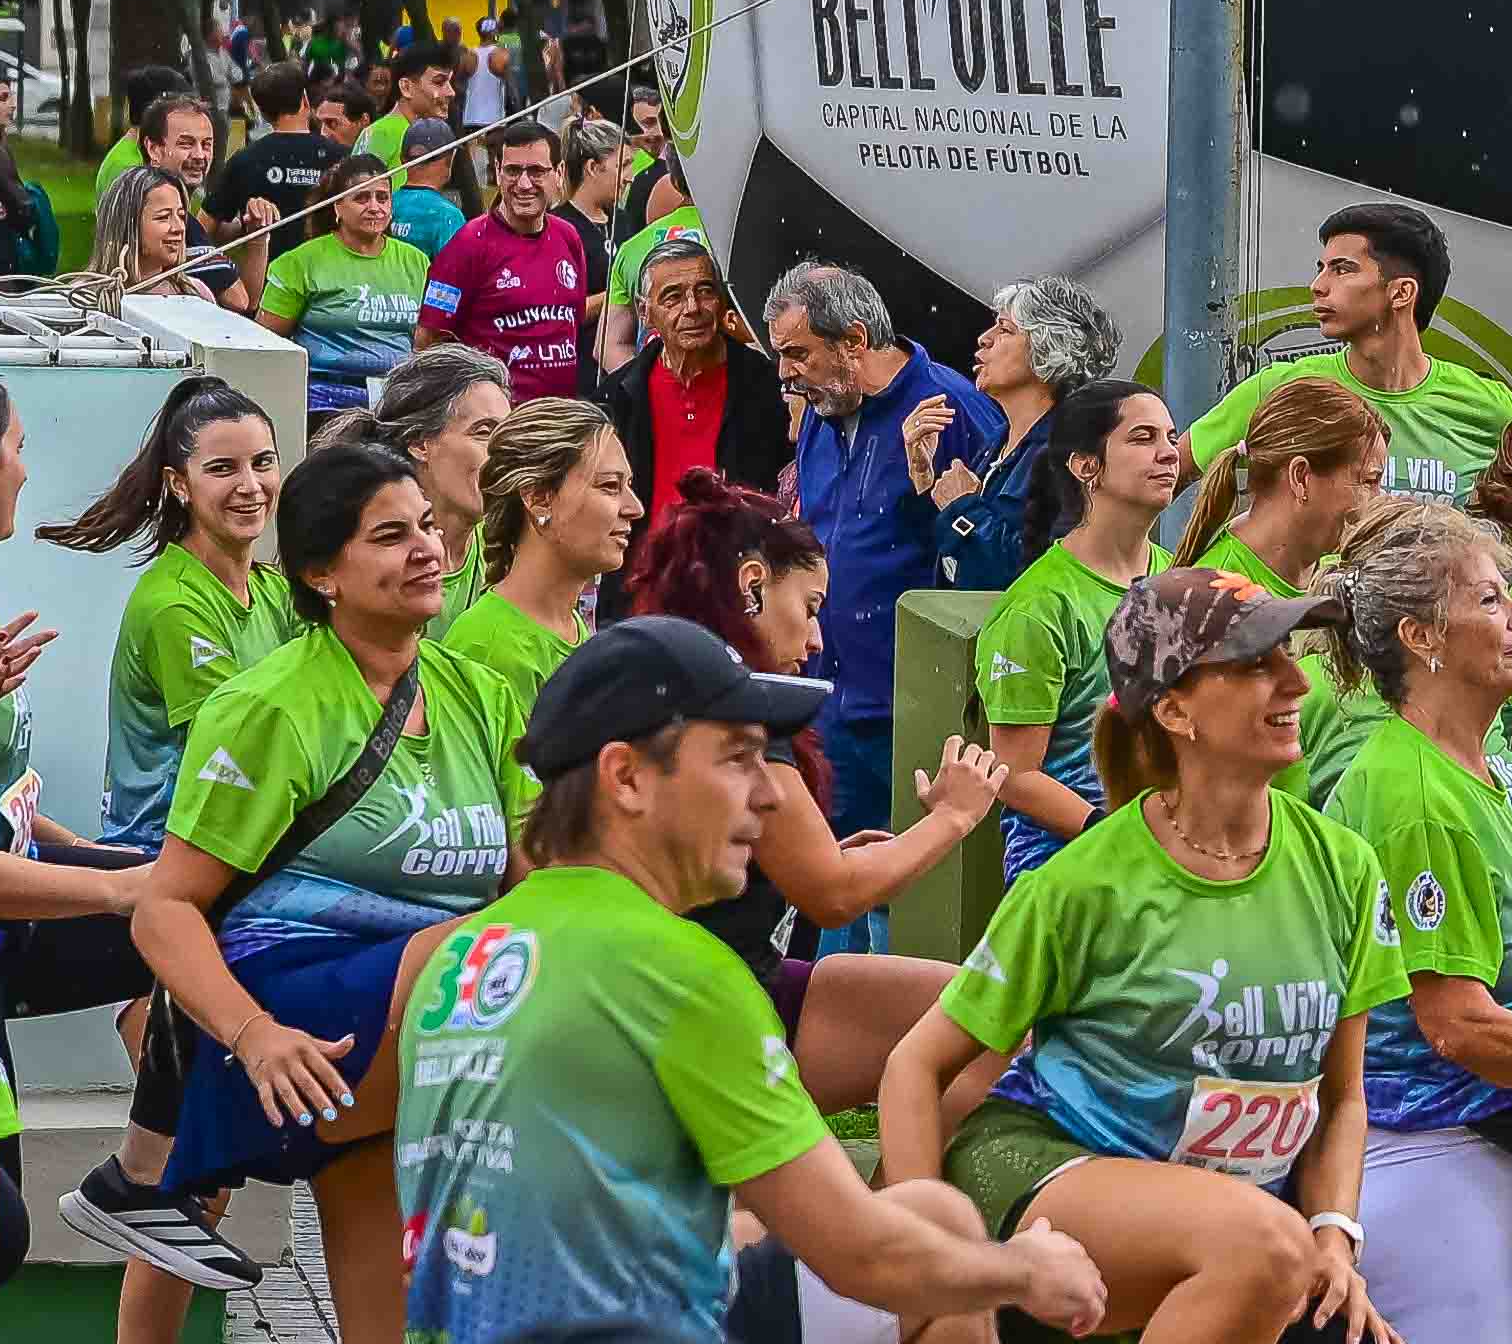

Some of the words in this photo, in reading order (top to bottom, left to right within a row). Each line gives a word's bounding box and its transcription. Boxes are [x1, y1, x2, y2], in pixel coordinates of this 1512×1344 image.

[821, 103, 909, 133] CAPITAL
[914, 105, 1041, 138] NACIONAL
[1048, 111, 1082, 139] DE
[1090, 113, 1128, 142] LA
[858, 143, 941, 172] PELOTA
[946, 145, 978, 173] DE
[983, 141, 1091, 178] FÚTBOL
[1406, 456, 1457, 494] Ville
[1188, 1092, 1312, 1159] 220
